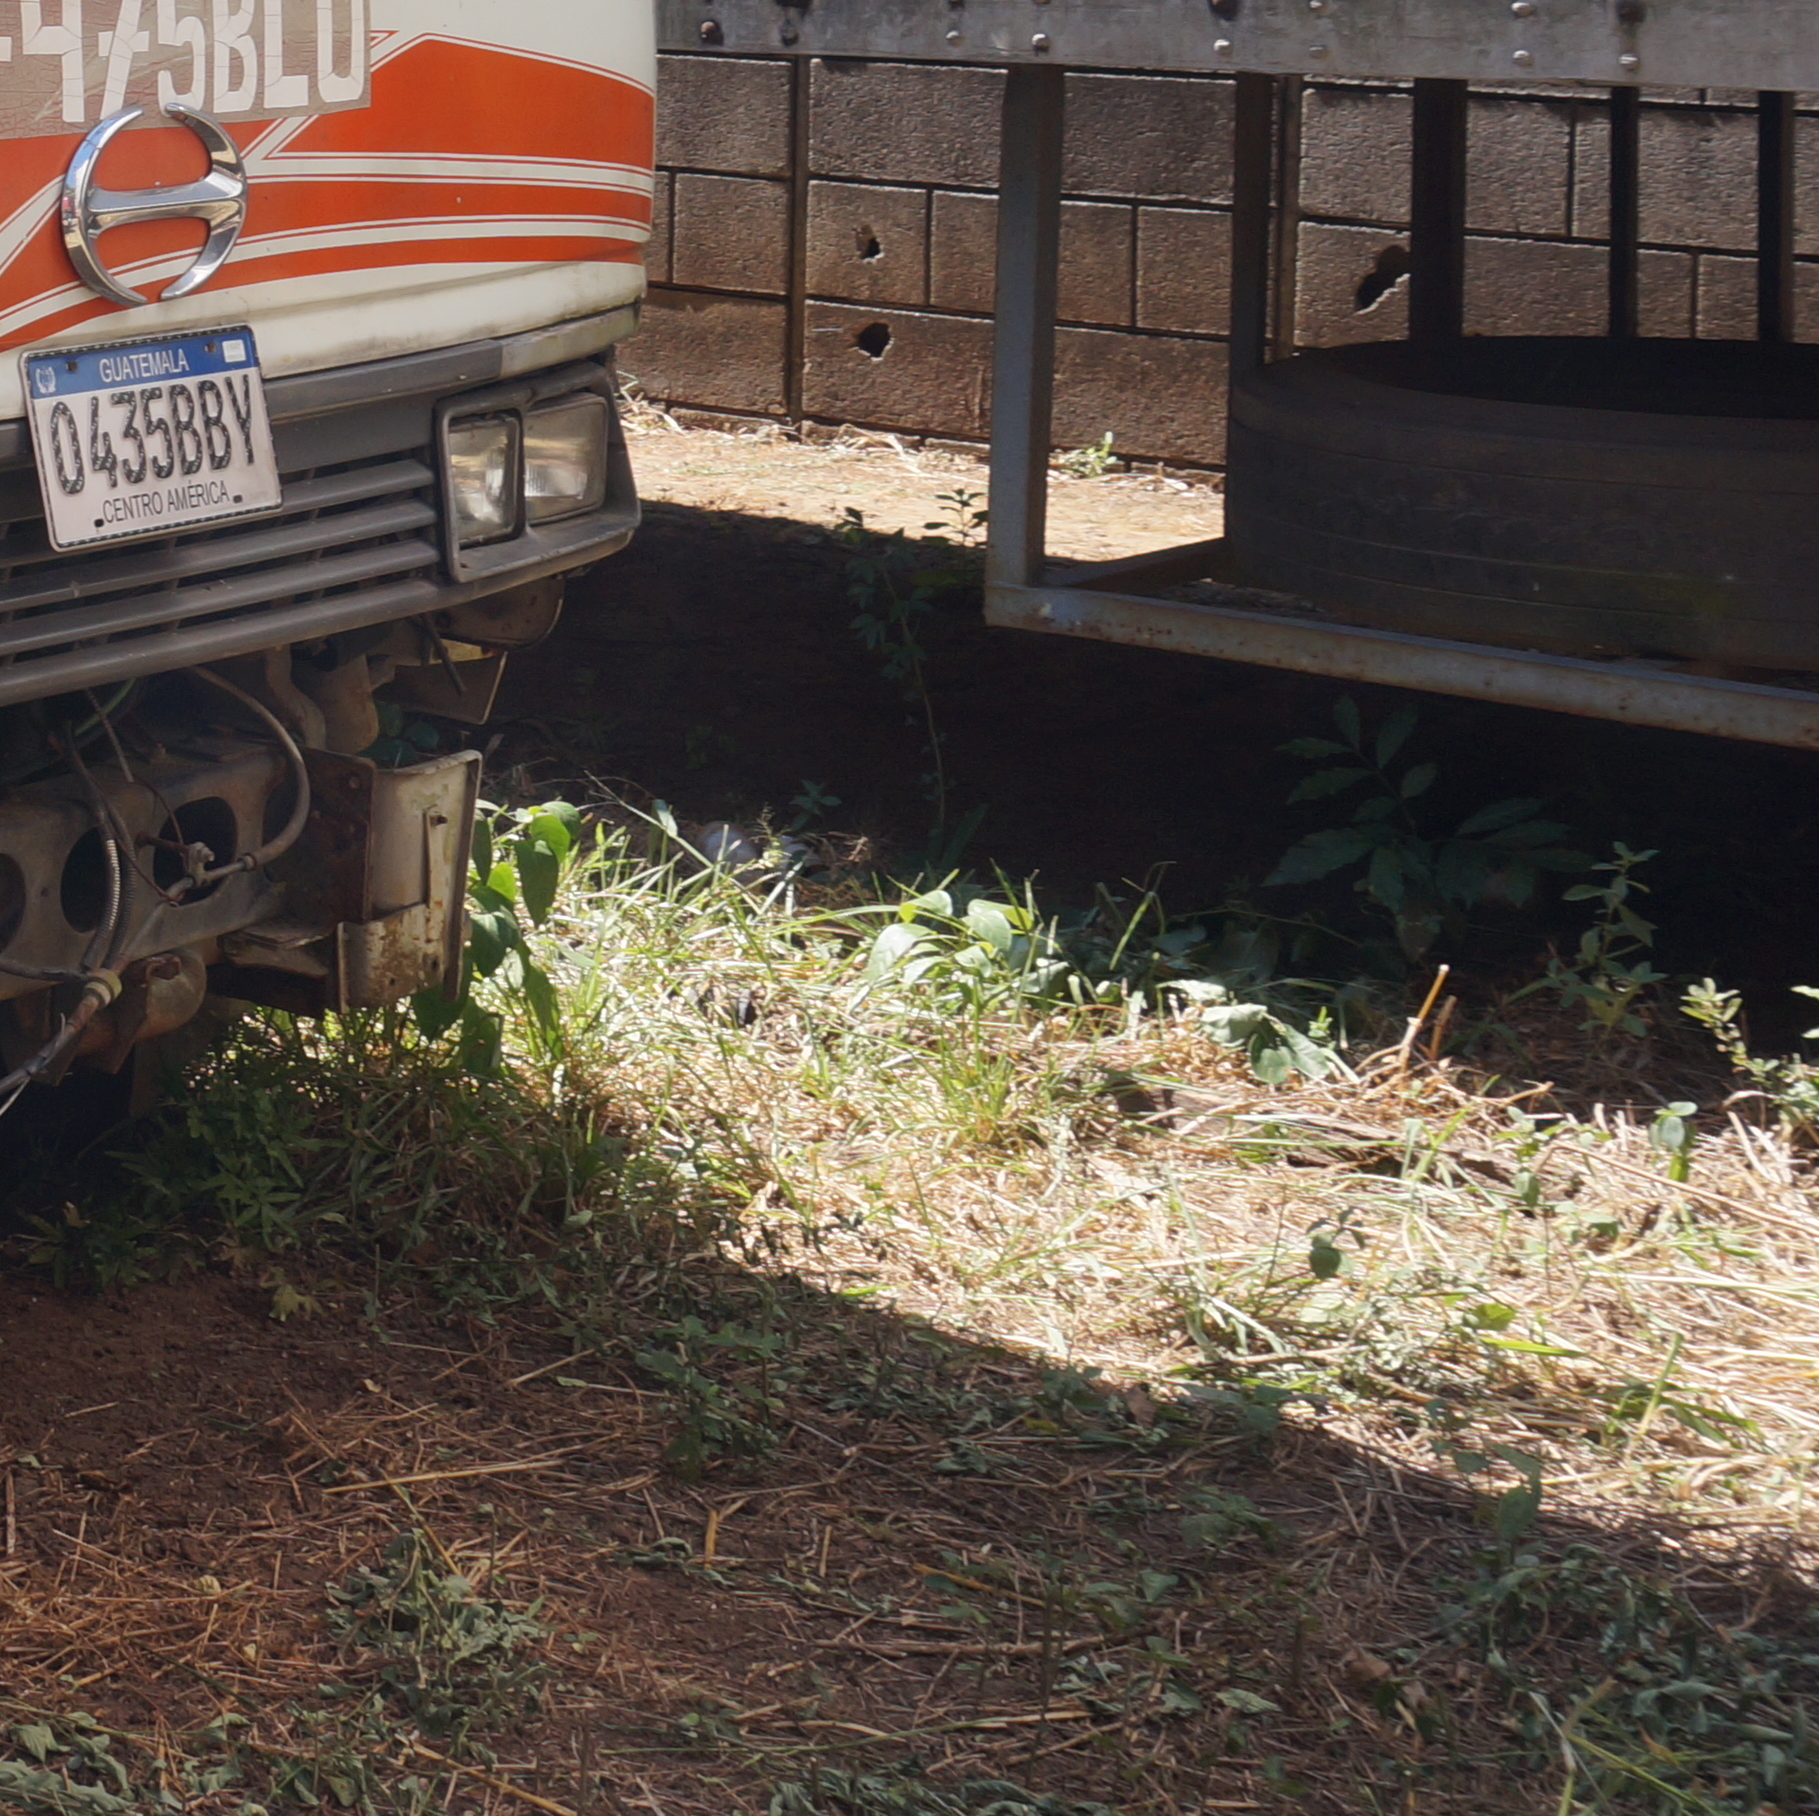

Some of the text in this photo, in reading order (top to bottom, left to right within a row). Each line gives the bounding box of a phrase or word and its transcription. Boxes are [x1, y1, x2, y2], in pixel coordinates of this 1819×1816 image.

[98, 347, 191, 384] GUATEMALA
[101, 479, 232, 525] CENTRO AMÉRICA
